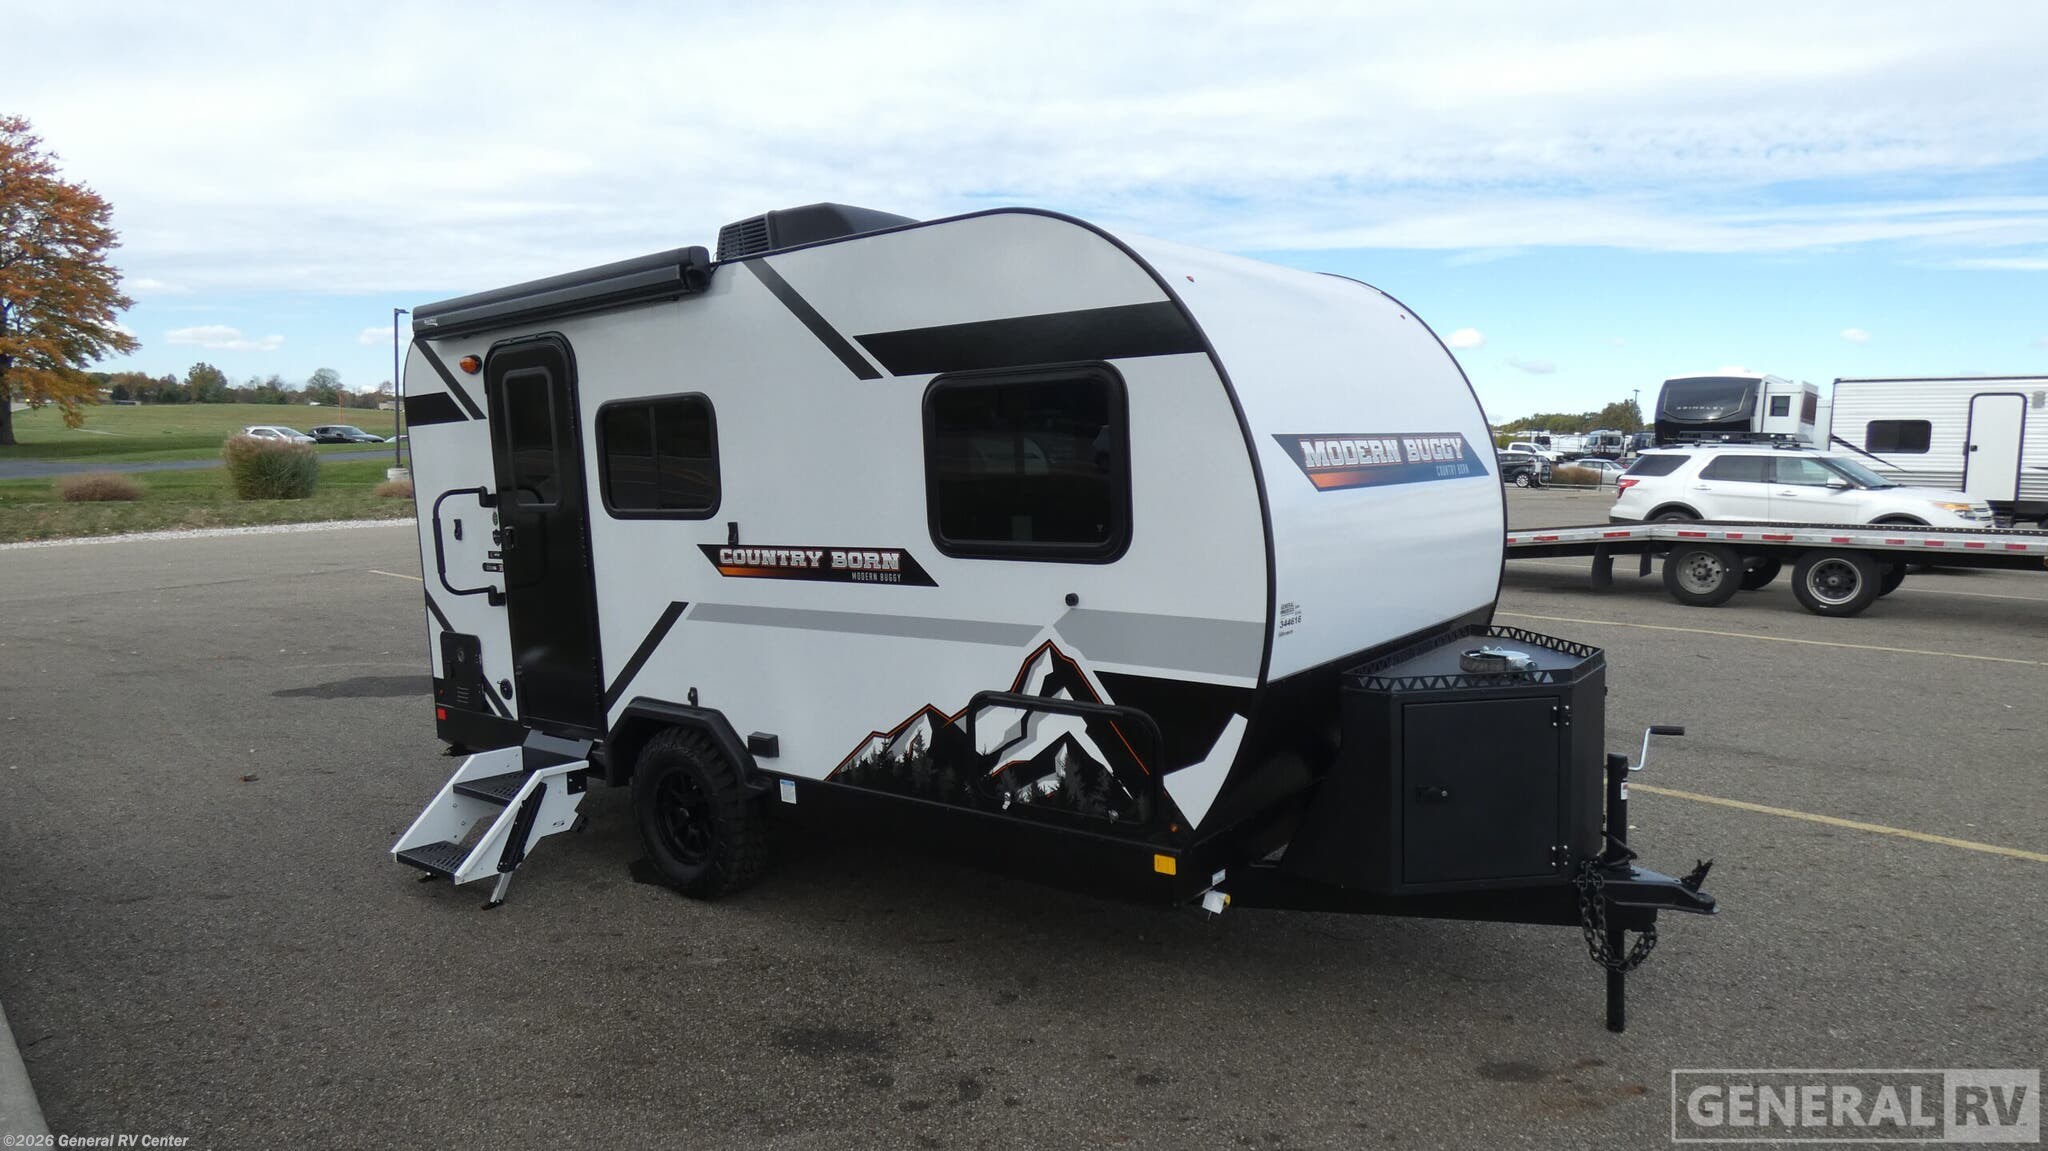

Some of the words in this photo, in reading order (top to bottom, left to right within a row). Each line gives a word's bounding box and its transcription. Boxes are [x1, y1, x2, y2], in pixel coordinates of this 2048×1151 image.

[1301, 438, 1402, 468] MODERN
[1404, 437, 1463, 462] BUGGY
[719, 548, 822, 567] COUNTRY
[831, 551, 900, 570] BORN
[851, 571, 878, 581] MODERN
[880, 572, 902, 582] BUGGY
